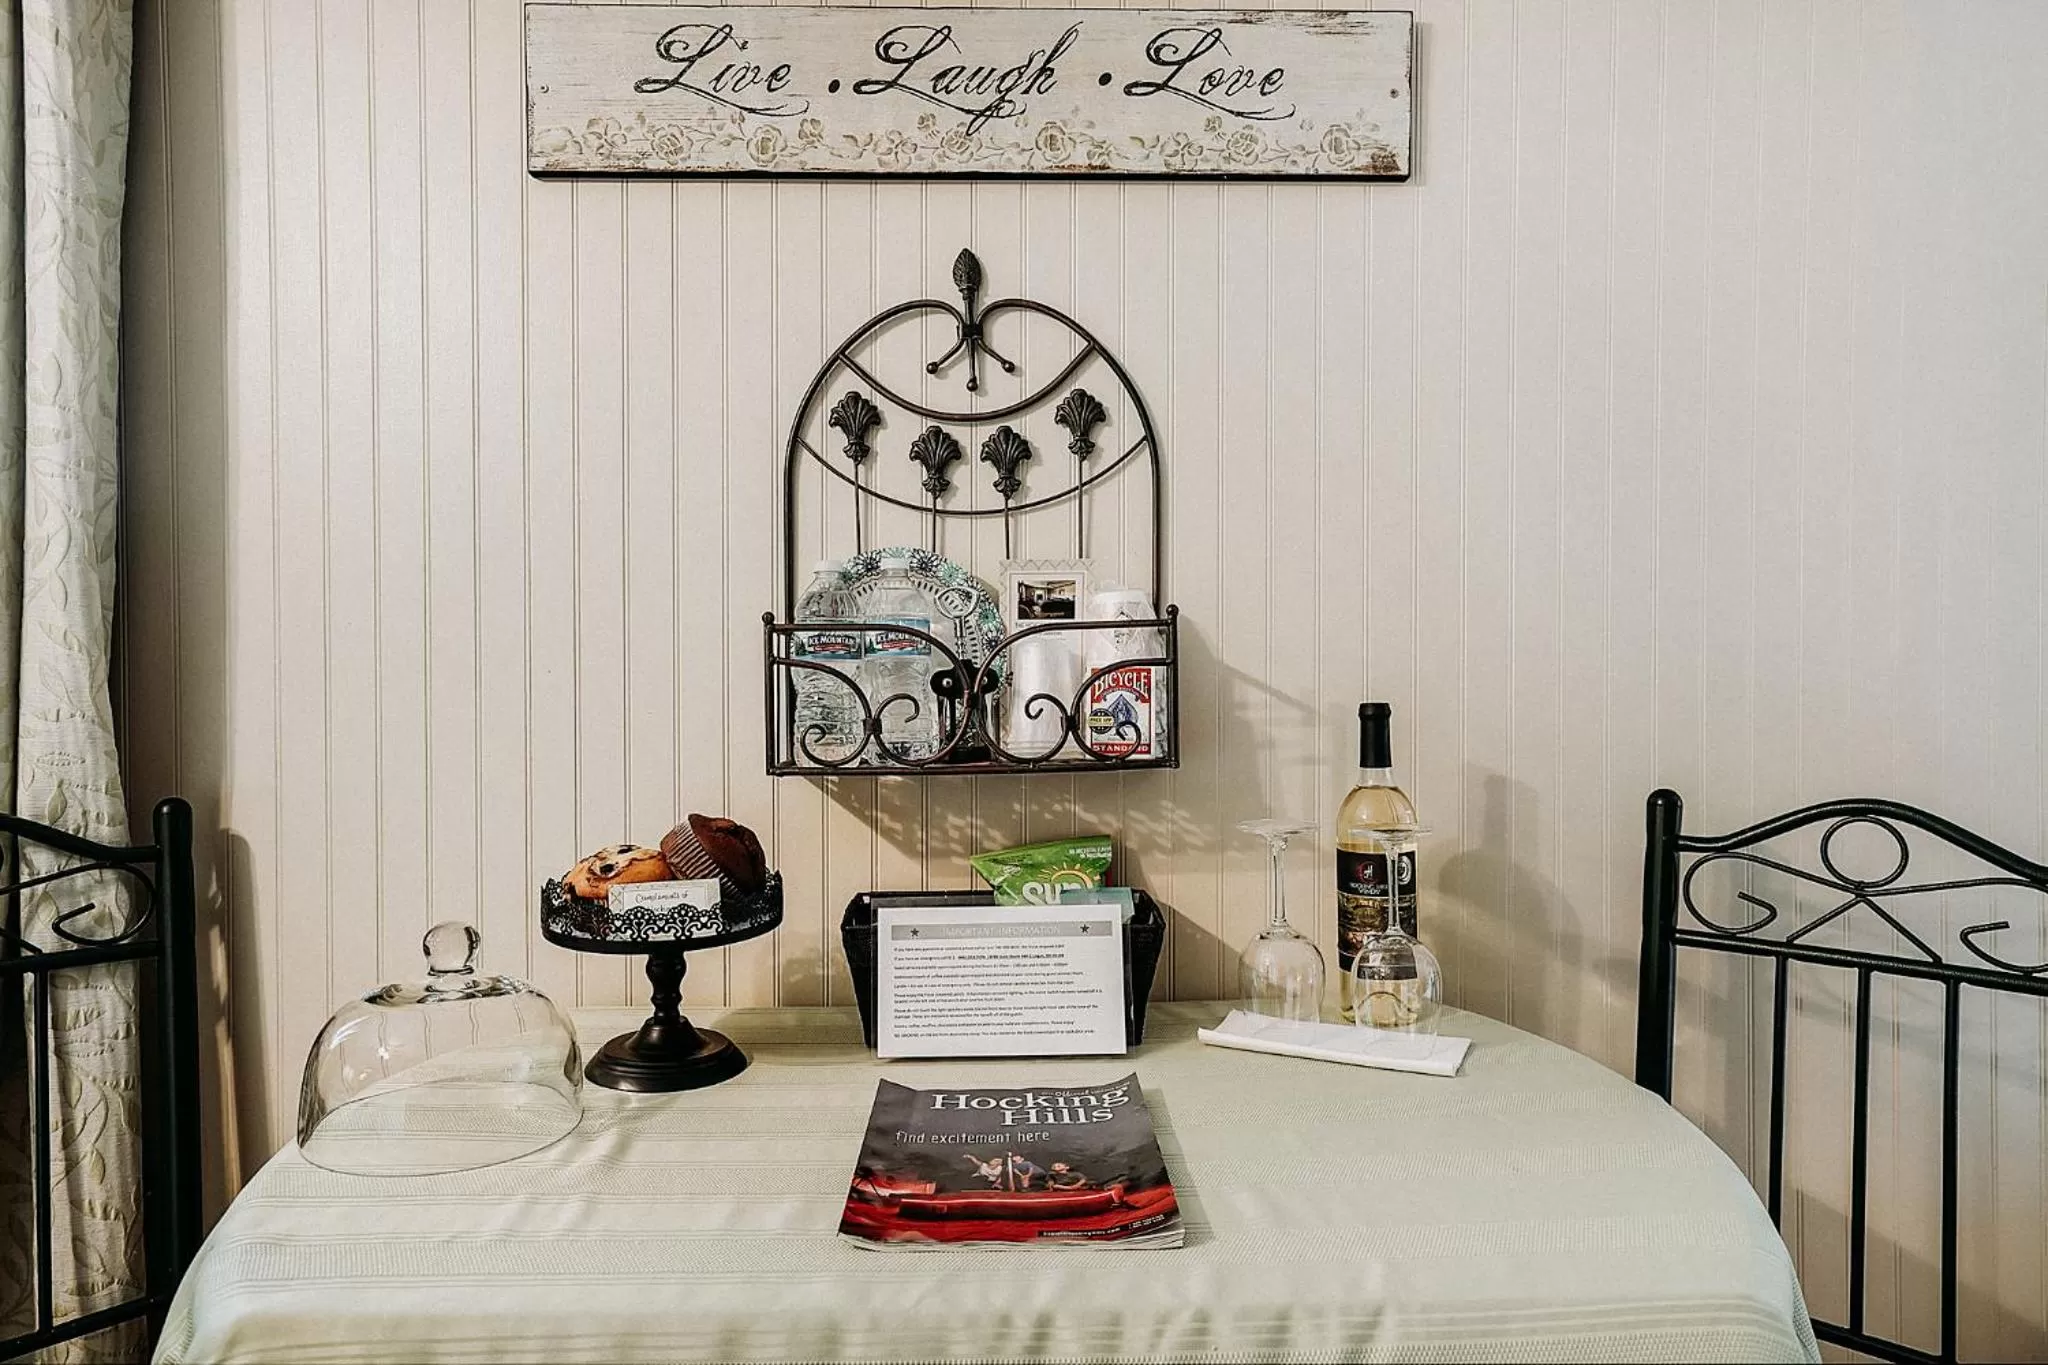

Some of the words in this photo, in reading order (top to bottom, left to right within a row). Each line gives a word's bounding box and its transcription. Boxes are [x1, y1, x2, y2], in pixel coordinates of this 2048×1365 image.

[633, 24, 810, 116] Live
[853, 20, 1084, 136] Laugh
[1123, 28, 1296, 120] Love
[1093, 671, 1149, 700] BICYCLE
[942, 927, 993, 937] IMPORTANT
[999, 925, 1061, 937] INFORMATION
[930, 1085, 1130, 1109] Hocking
[1000, 1107, 1114, 1126] Hills
[895, 1130, 925, 1144] find
[931, 1131, 1010, 1144] excitement
[1017, 1130, 1050, 1143] here
